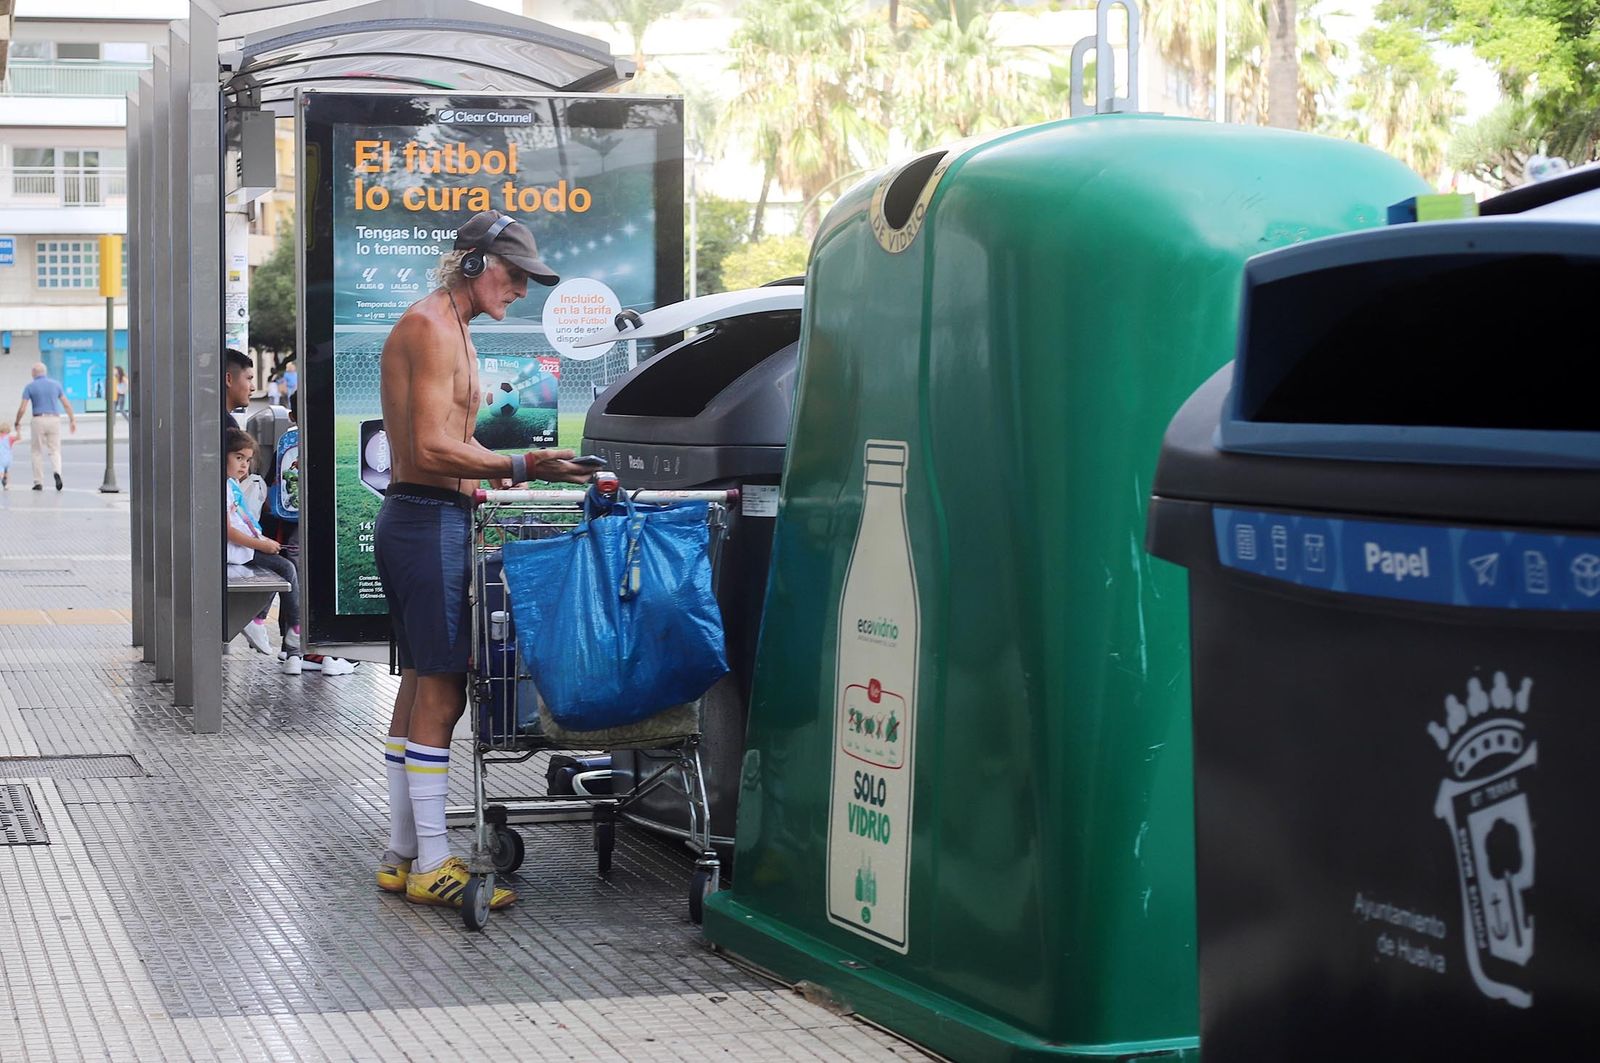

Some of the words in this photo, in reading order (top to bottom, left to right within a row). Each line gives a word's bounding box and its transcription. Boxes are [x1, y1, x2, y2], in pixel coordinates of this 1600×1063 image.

[455, 111, 485, 122] Clear
[486, 112, 532, 123] Channel
[354, 140, 391, 173] El
[354, 178, 390, 211] lo
[402, 185, 490, 212] cura
[502, 180, 593, 213] todo
[355, 226, 410, 242] Tengas
[413, 227, 428, 240] lo
[873, 215, 885, 241] DE
[888, 203, 925, 251] VIDRIO
[356, 243, 370, 256] lo
[373, 244, 444, 256] tenemos.
[356, 301, 397, 309] Temporada
[553, 306, 567, 315] en
[570, 305, 580, 315] la
[583, 305, 612, 315] tarifa
[560, 294, 605, 304] Incluido
[558, 317, 579, 325] Love
[574, 326, 585, 334] de
[538, 364, 560, 373] 2023
[376, 430, 387, 473] Galaxy
[1364, 542, 1429, 582] Papel
[853, 770, 887, 808] SOLO
[848, 802, 891, 845] VIDRIO
[1353, 892, 1446, 939] Ayuntamiento
[1377, 932, 1396, 957] de
[1397, 936, 1446, 974] Huelva
